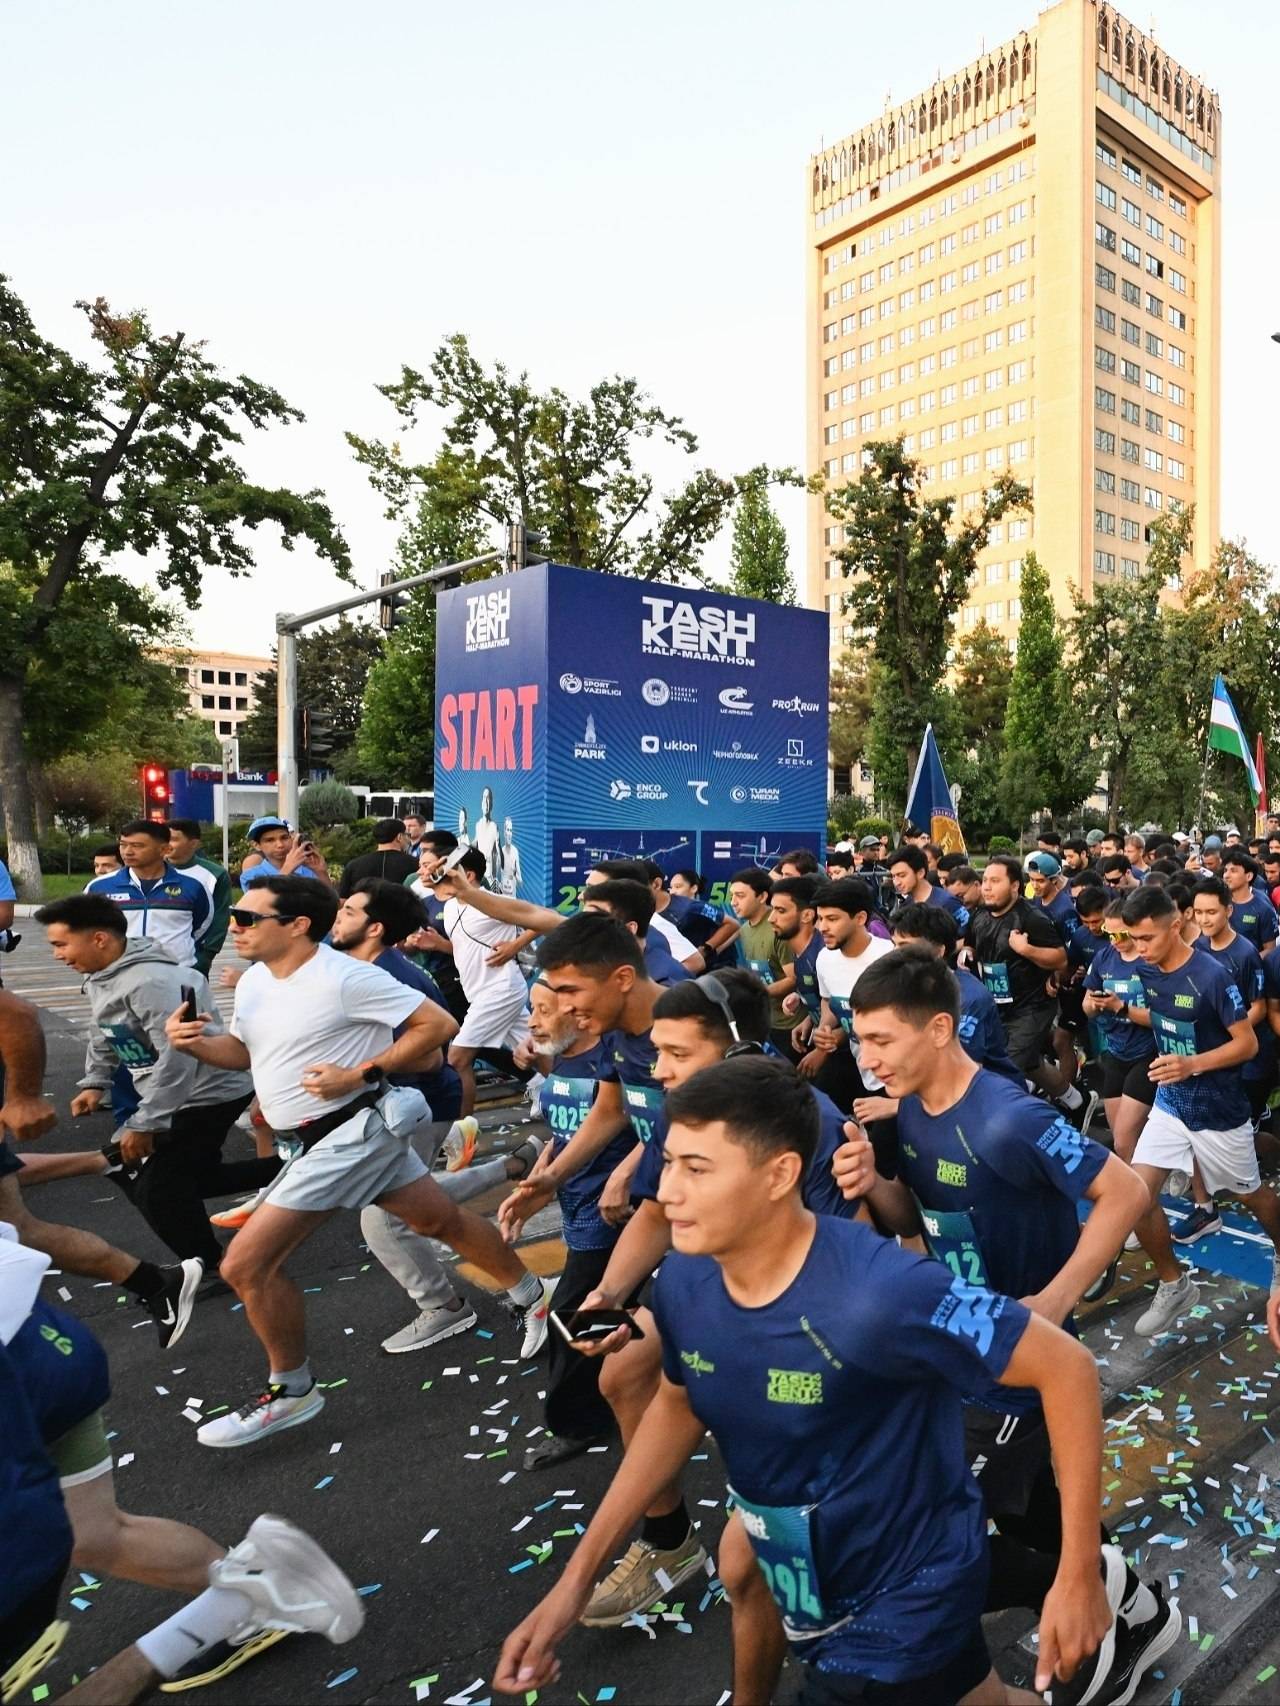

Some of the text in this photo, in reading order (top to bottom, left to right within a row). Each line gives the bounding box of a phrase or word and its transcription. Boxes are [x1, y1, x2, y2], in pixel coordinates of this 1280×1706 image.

[466, 588, 511, 621] TASH
[642, 596, 755, 643] TASH
[465, 616, 508, 645] KENT
[642, 619, 748, 658] KENT
[642, 645, 756, 667] HALF-MARATHON
[584, 680, 610, 689] SPORT
[584, 687, 622, 697] VAZIRLIGI
[772, 699, 819, 713] PRO RUN
[440, 684, 538, 772] START
[664, 740, 698, 753] uklon
[575, 748, 606, 760] PARK
[778, 758, 813, 766] ZEEKR
[237, 772, 264, 781] Bank
[636, 783, 662, 792] ENCO
[636, 791, 668, 801] GROUP
[751, 793, 780, 801] MEDIA
[768, 1370, 814, 1390] TASH
